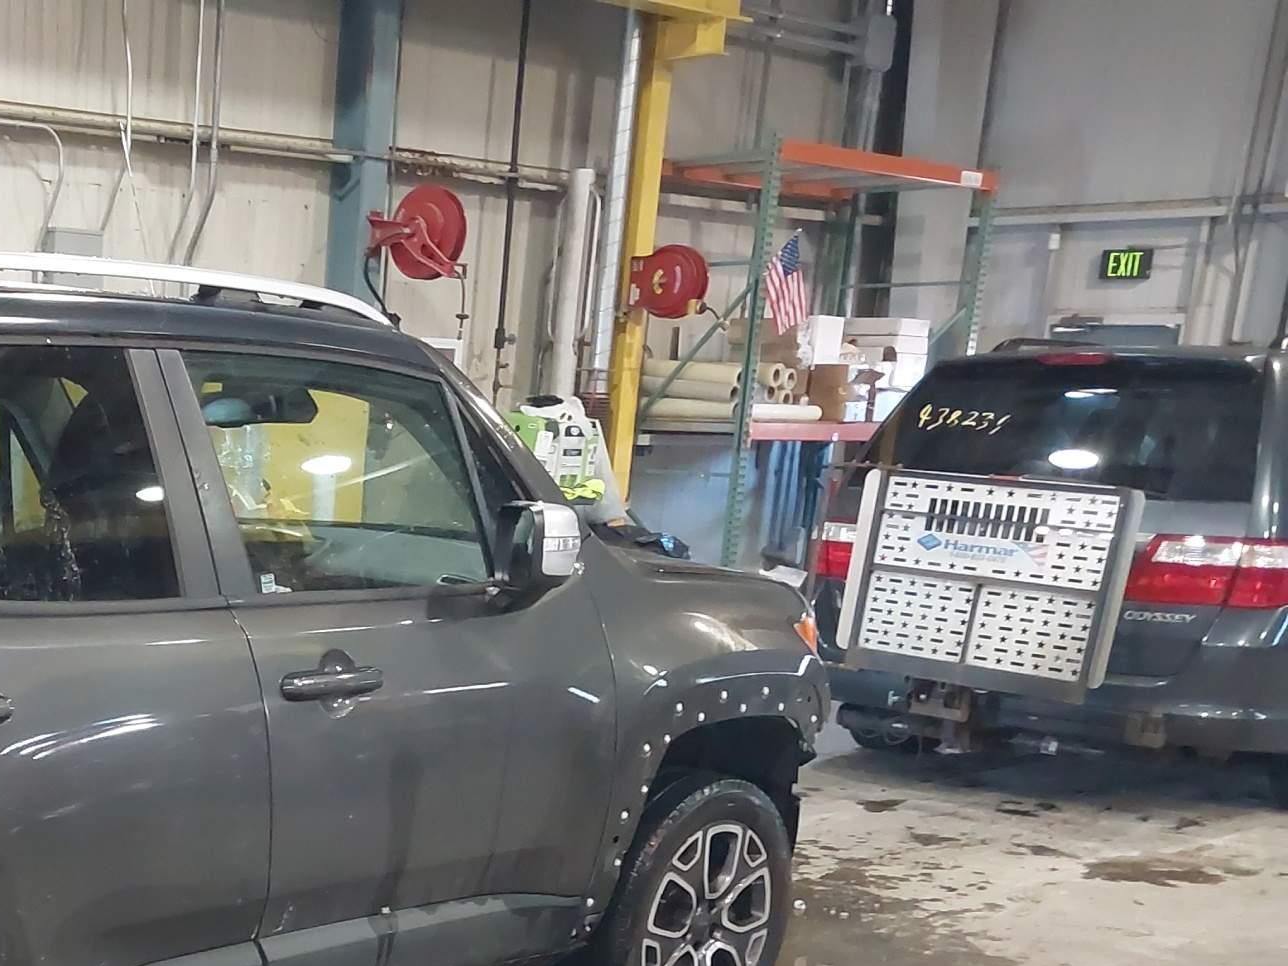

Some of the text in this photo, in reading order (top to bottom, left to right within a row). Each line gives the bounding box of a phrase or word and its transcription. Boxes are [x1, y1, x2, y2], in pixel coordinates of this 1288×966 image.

[1106, 251, 1145, 277] EXIT
[943, 538, 1019, 558] Harmar
[1123, 610, 1197, 624] ODYSSEY
